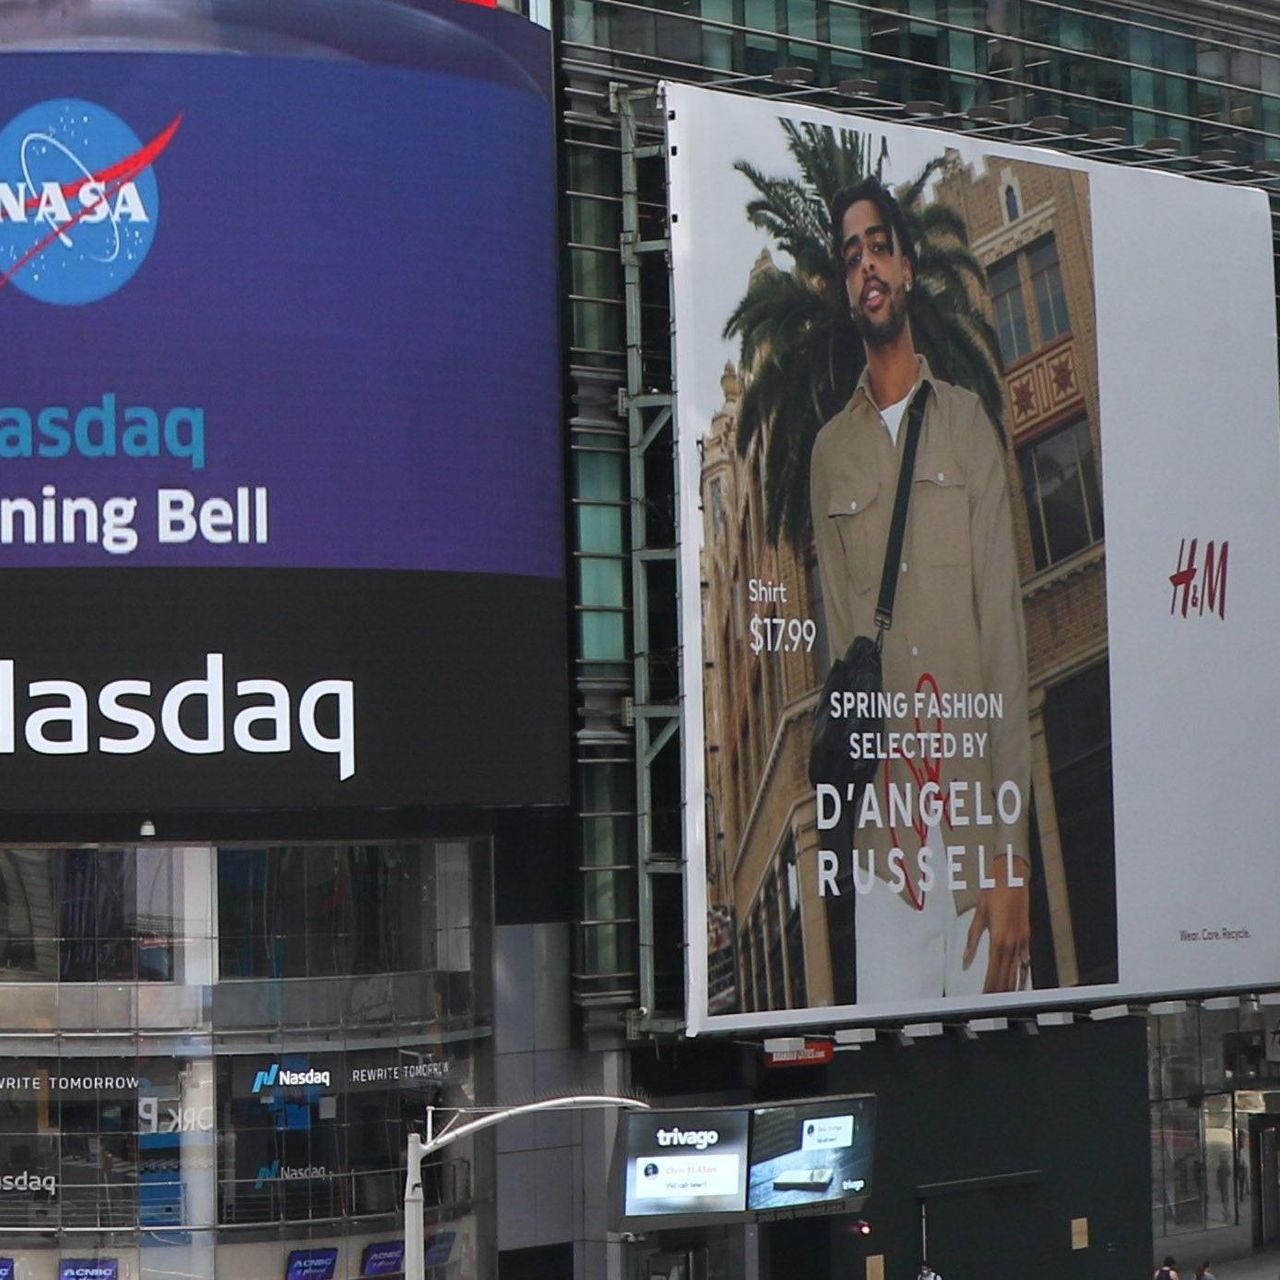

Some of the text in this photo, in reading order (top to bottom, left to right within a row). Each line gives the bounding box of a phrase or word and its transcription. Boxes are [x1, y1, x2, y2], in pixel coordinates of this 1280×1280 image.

[158, 487, 268, 544] Bell
[748, 578, 787, 604] Shirt
[1169, 537, 1230, 620] H&M
[749, 617, 817, 655] $17.99
[830, 691, 1004, 720] SPRING FASHION
[849, 732, 988, 760] SELECTED BY
[816, 779, 1022, 830] D'ANGELO
[818, 845, 1024, 897] RUSSELL
[48, 1076, 139, 1090] TOMORROW
[279, 1068, 331, 1086] Nasdaq
[352, 1066, 400, 1082] REWRITE
[656, 1127, 719, 1150] trivago
[280, 1166, 326, 1181] Nasdaq
